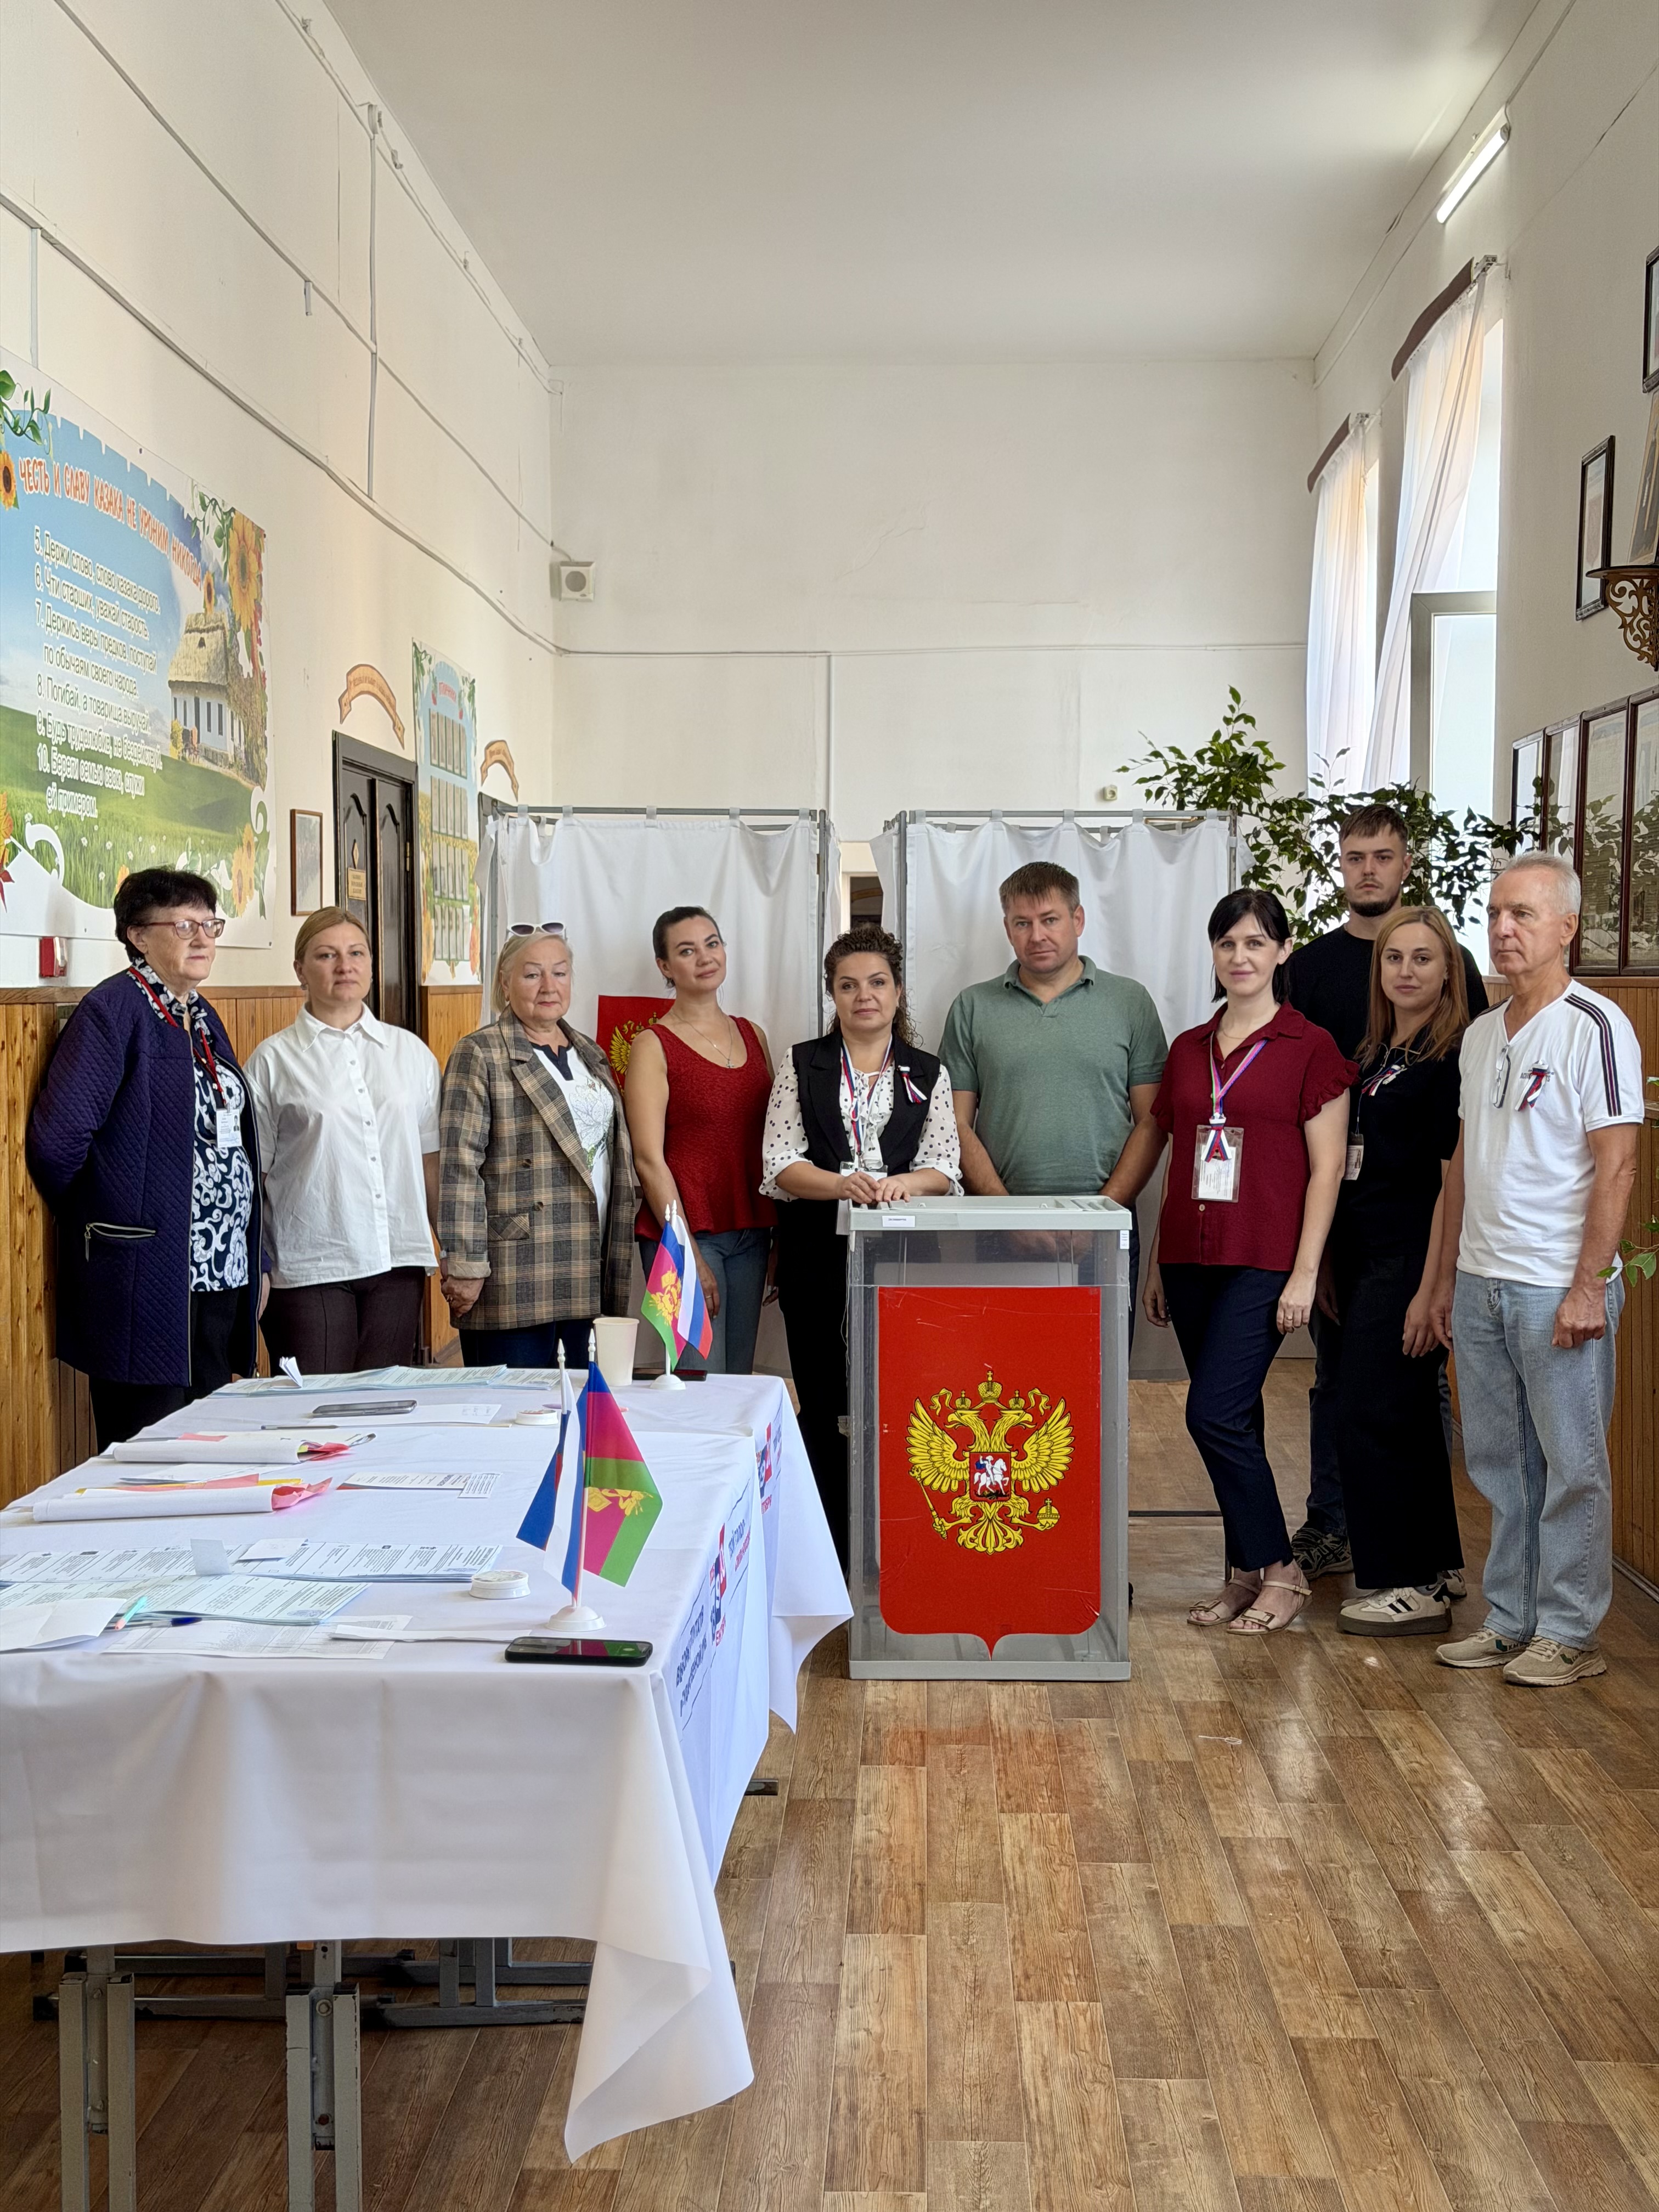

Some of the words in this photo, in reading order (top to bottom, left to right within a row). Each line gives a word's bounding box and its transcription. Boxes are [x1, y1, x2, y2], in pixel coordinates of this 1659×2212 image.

[19, 457, 50, 495] ЧЕСТЬ
[53, 461, 61, 498] И
[64, 462, 90, 506] СЛАВУ
[94, 475, 125, 524] КАЗАКА
[126, 495, 137, 530] НЕ
[138, 504, 169, 558] УРОНИМ
[171, 531, 201, 591] НИКОГДА
[35, 525, 43, 556] 5.
[44, 530, 70, 569] Держи
[71, 550, 95, 584] слово,
[95, 563, 116, 592] слово
[116, 574, 138, 603] казака
[138, 586, 160, 614] дорого.
[36, 562, 43, 592] 6.
[44, 566, 60, 599] Чти
[61, 580, 95, 618] старших,
[95, 596, 120, 627] уважай
[121, 608, 149, 640] старость.
[36, 598, 44, 628] 7.
[45, 602, 80, 641] Держись
[81, 623, 99, 653] веры
[129, 645, 157, 675] поступай
[43, 643, 54, 665] по
[55, 644, 90, 679] обычаям
[91, 662, 114, 687] своего
[114, 674, 139, 700] народа.
[37, 673, 44, 697] 8.
[47, 676, 81, 713] Погибай,
[83, 695, 88, 711] а
[89, 696, 122, 726] товарища
[123, 708, 151, 735] выручай.
[37, 709, 45, 736] 9.
[47, 712, 66, 745] Будь
[67, 724, 112, 759] трудолюбив,
[113, 736, 122, 758] не
[37, 742, 50, 774] 10.
[51, 746, 78, 782] Береги
[80, 759, 104, 786] семью
[104, 766, 123, 794] свою,
[46, 782, 57, 810] ей
[58, 789, 98, 821] примером.
